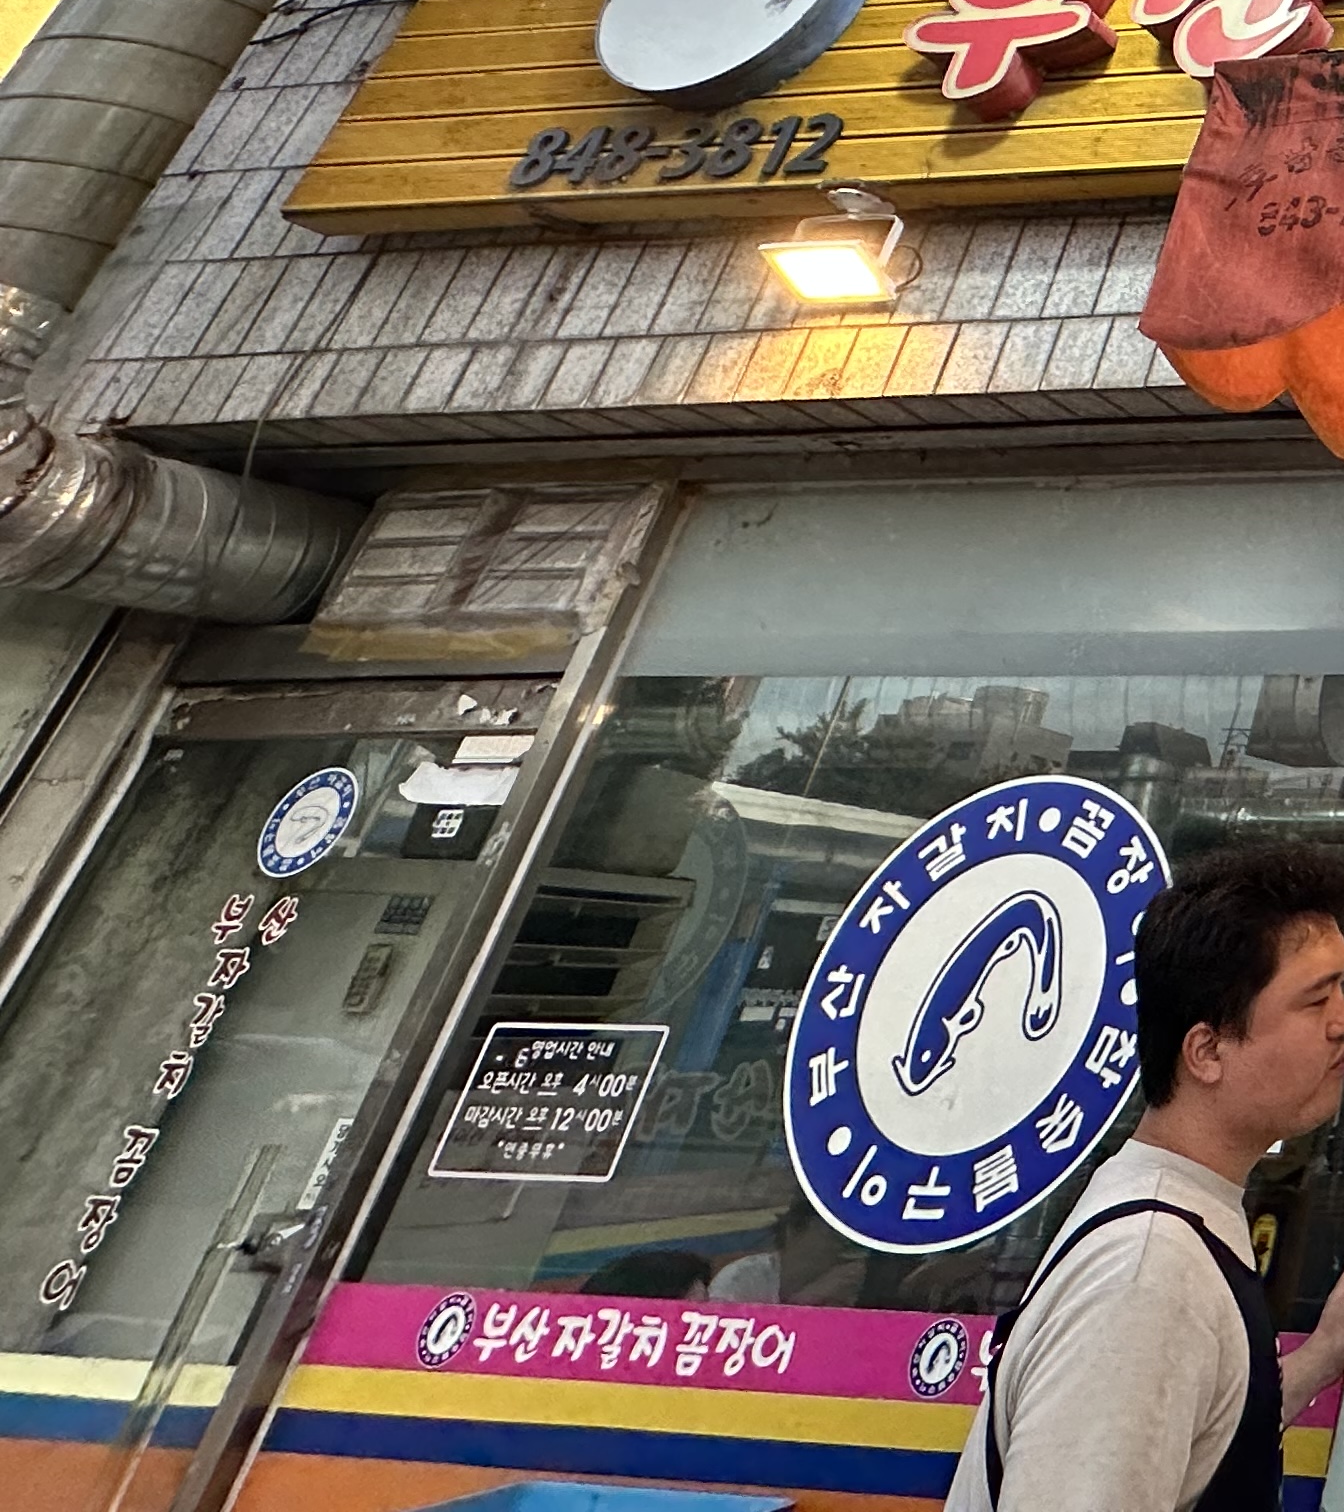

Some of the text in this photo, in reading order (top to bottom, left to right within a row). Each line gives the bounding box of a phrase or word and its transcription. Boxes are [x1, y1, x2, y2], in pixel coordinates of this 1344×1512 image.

[509, 113, 845, 189] 848-3812
[210, 893, 300, 945] 부산
[531, 1040, 615, 1061] 영업시간 안내
[477, 1072, 538, 1094] 오픈시간
[464, 1105, 524, 1128] 마감시간
[472, 1302, 551, 1365] 부산
[555, 1306, 669, 1370] 자갈치
[675, 1310, 798, 1378] 꼼장어
